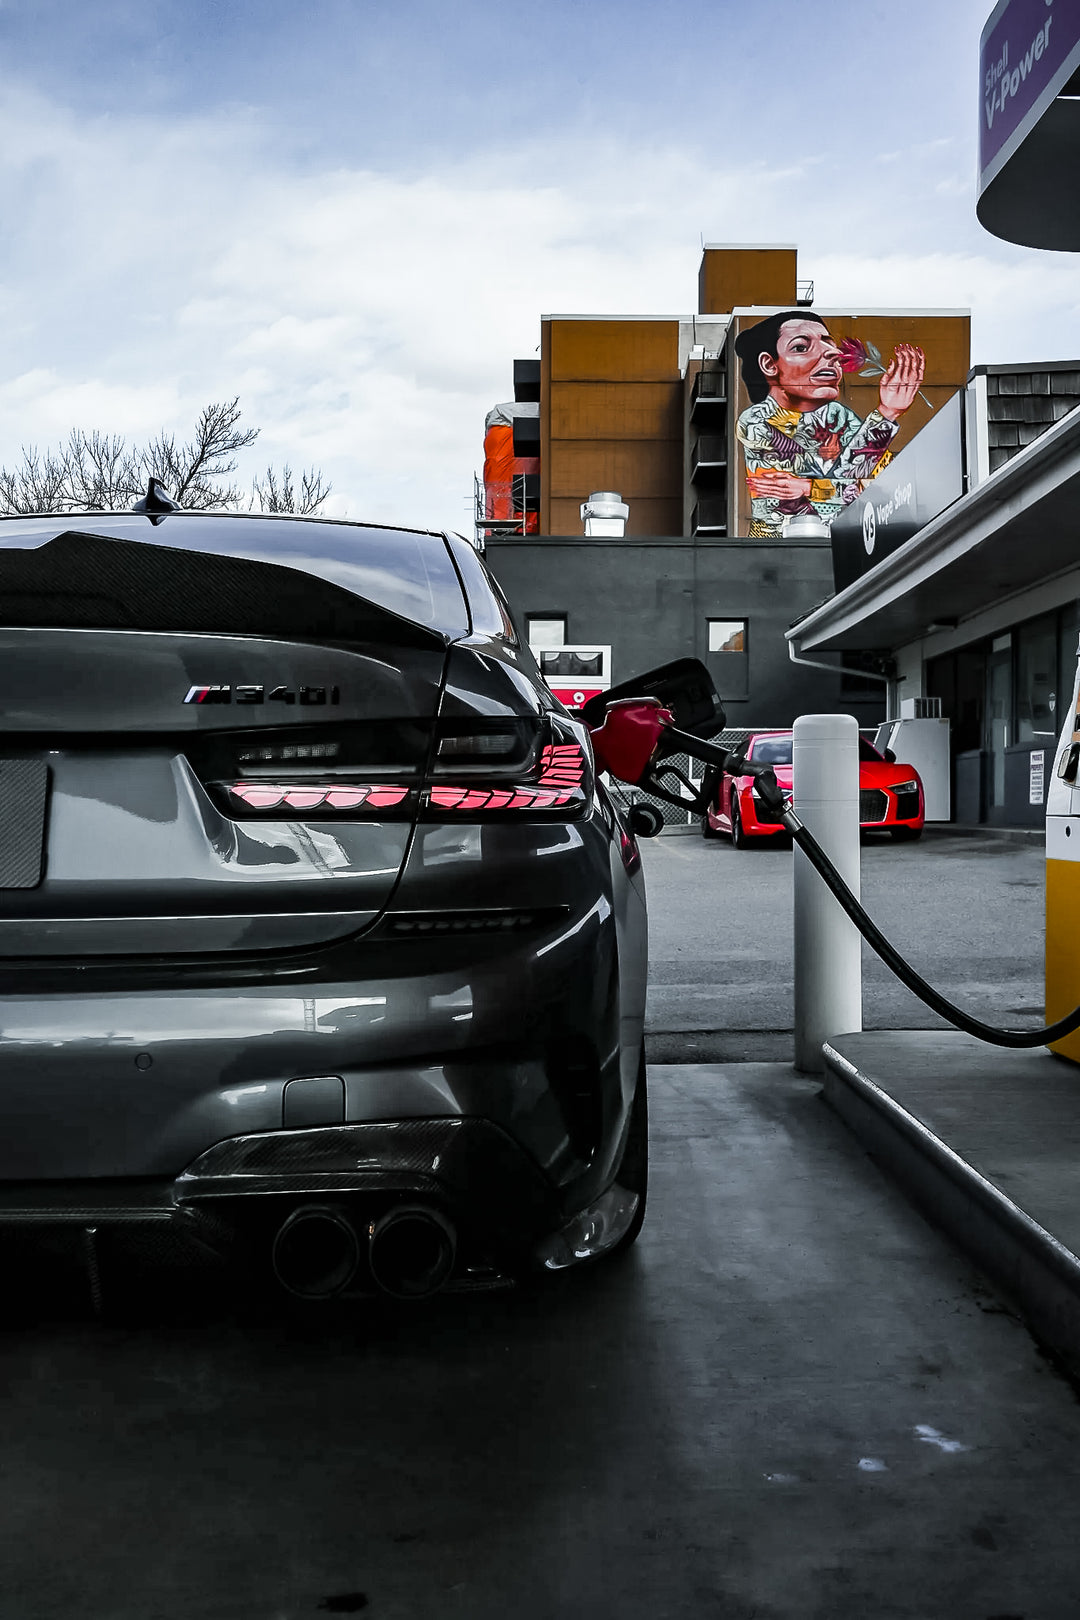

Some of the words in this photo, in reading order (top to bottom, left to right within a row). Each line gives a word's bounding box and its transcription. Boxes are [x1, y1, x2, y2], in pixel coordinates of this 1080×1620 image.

[985, 40, 1008, 96] Shell
[985, 15, 1052, 129] V-Power
[864, 514, 874, 541] VS
[877, 500, 893, 525] Vape
[895, 482, 912, 509] Shop
